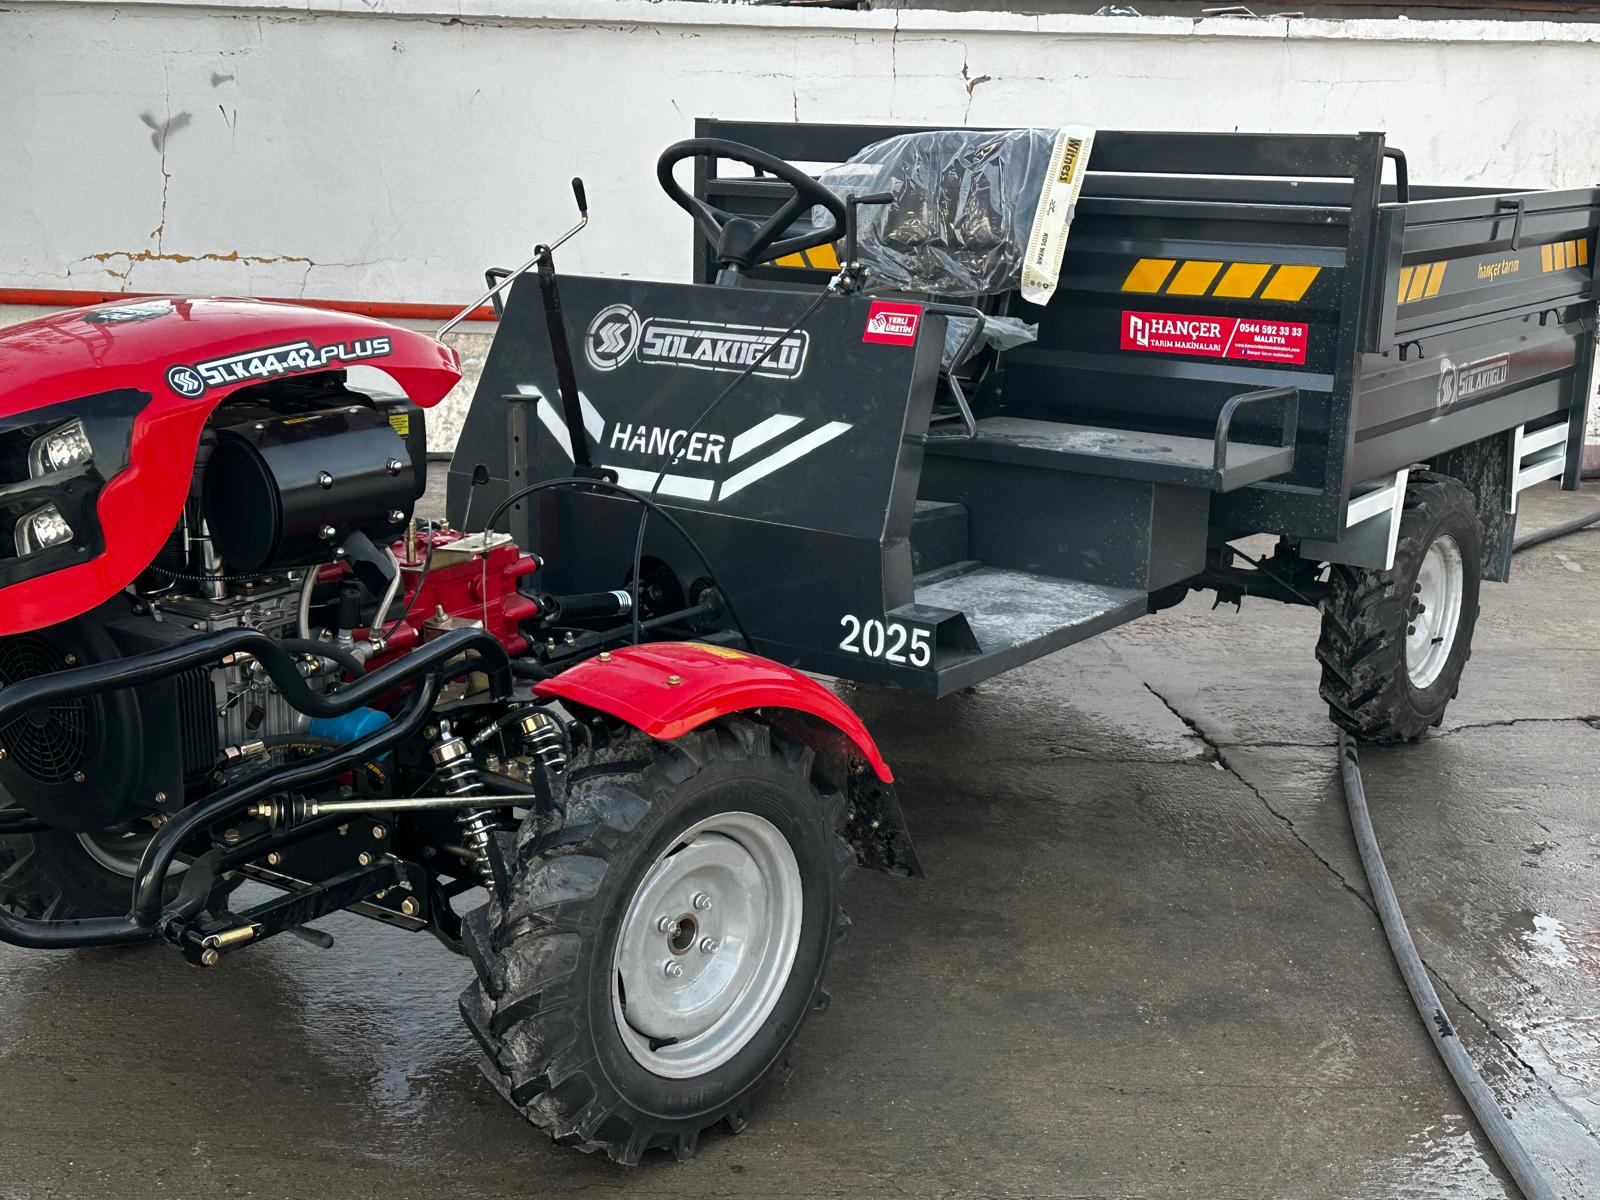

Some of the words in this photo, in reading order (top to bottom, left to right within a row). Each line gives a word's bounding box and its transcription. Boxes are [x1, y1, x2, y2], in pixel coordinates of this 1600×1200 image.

[1059, 138, 1081, 183] Witness
[1150, 319, 1221, 340] HANÇER
[1239, 323, 1260, 333] 0544
[1261, 325, 1277, 335] 592
[1279, 326, 1290, 336] 33
[1291, 327, 1302, 337] 33
[1254, 335, 1285, 344] MALATYA
[1150, 339, 1173, 348] TARIM
[1174, 341, 1221, 352] MAKİNALARI
[610, 422, 725, 465] HANÇER
[839, 614, 931, 667] 2025
